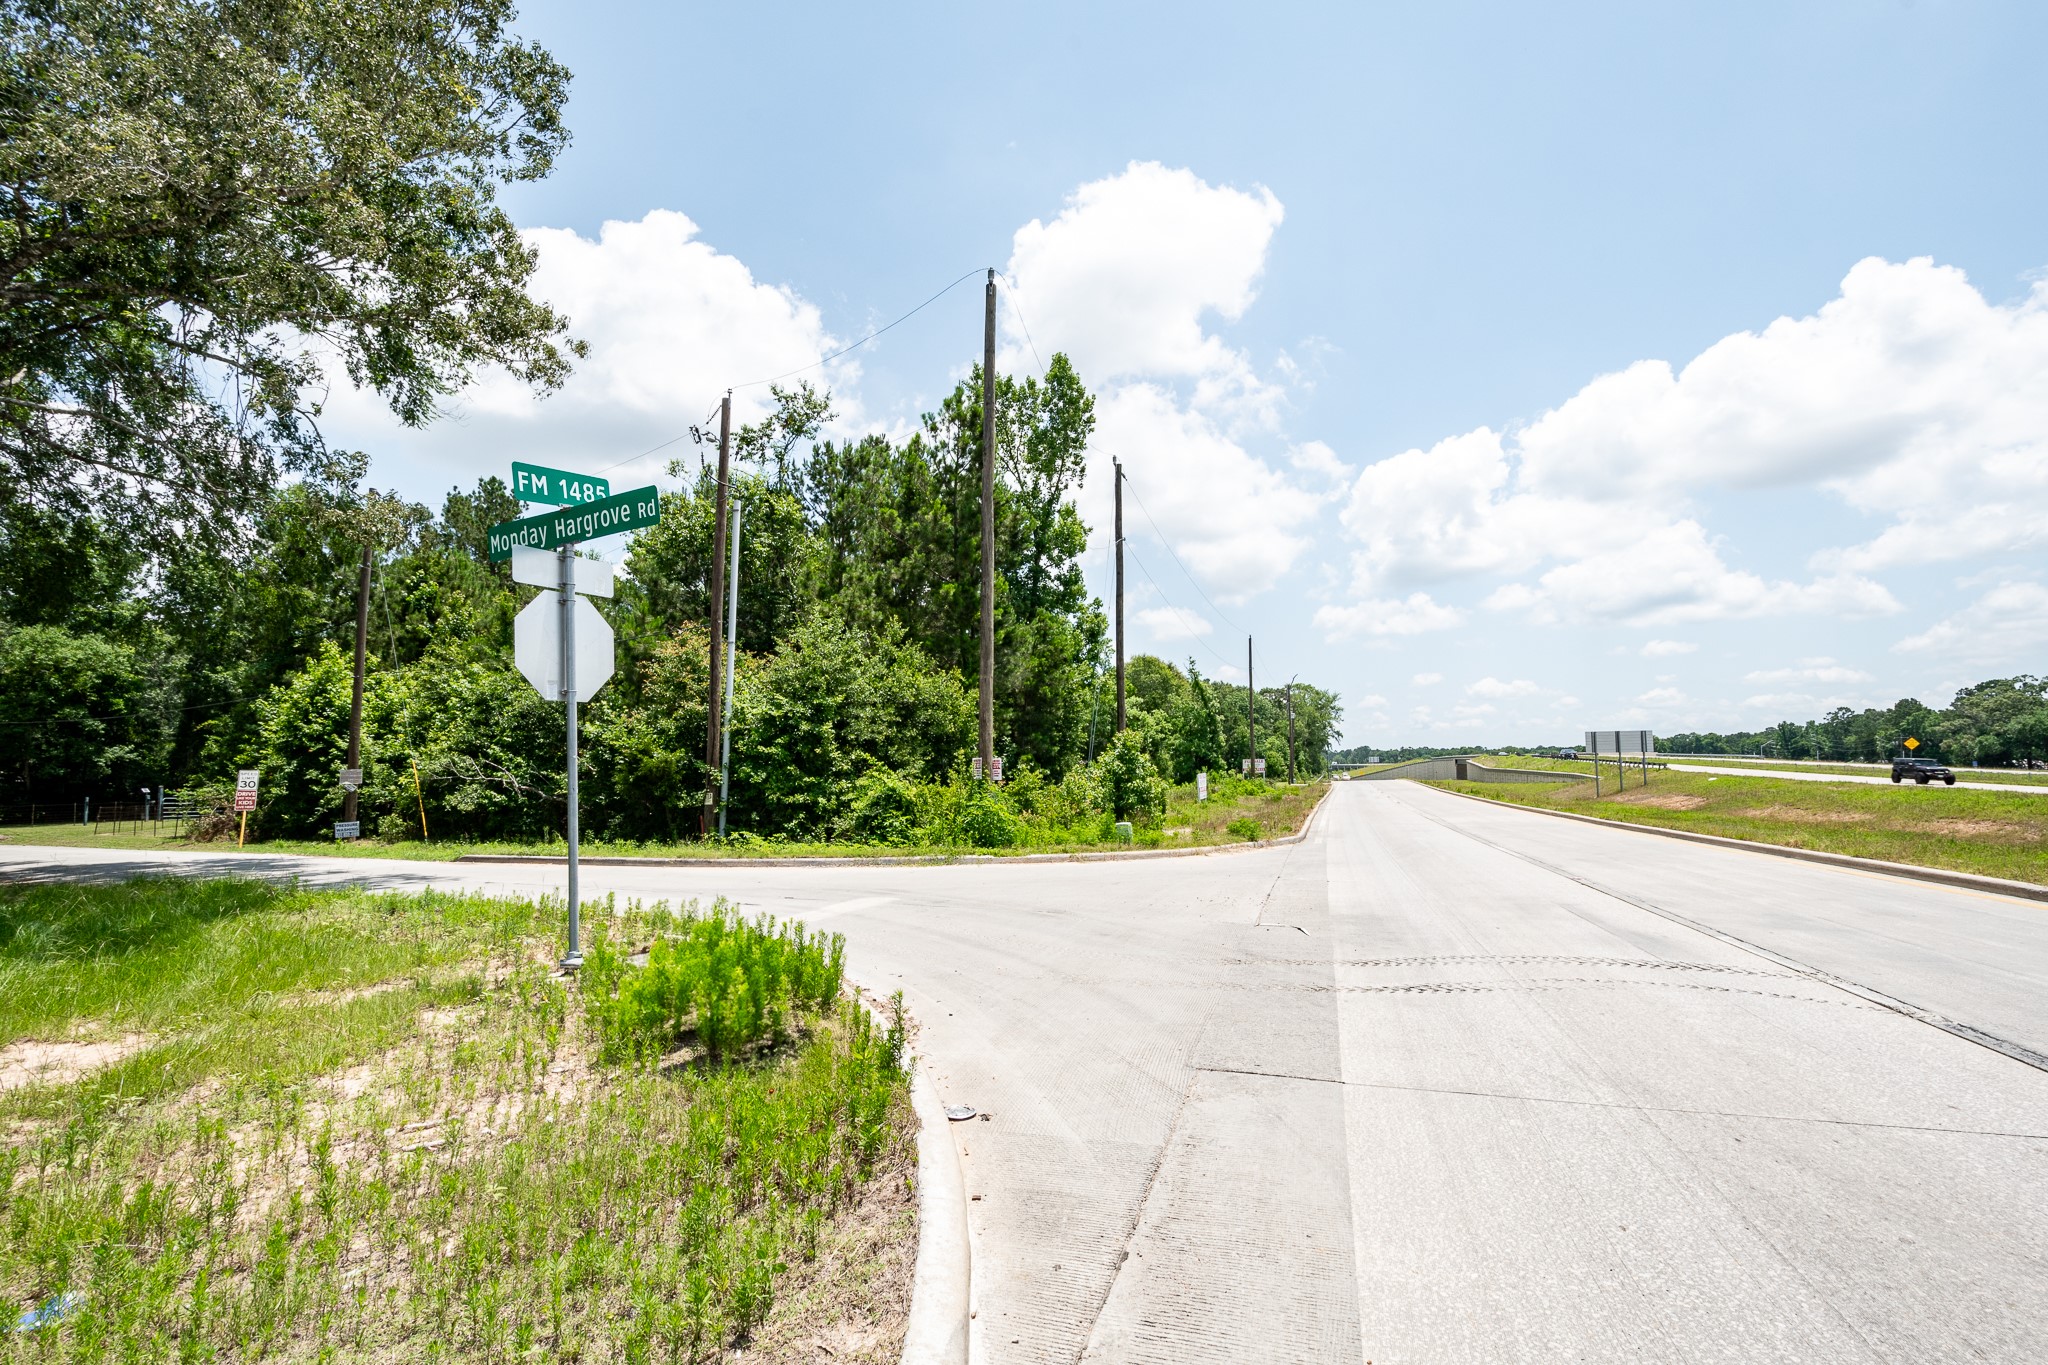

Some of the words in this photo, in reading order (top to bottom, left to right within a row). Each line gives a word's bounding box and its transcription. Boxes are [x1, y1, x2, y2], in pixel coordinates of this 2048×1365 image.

[517, 470, 549, 496] FM
[558, 478, 606, 503] 1485
[490, 525, 547, 554] Monday
[555, 504, 631, 538] Hargrove
[638, 498, 656, 519] Rd
